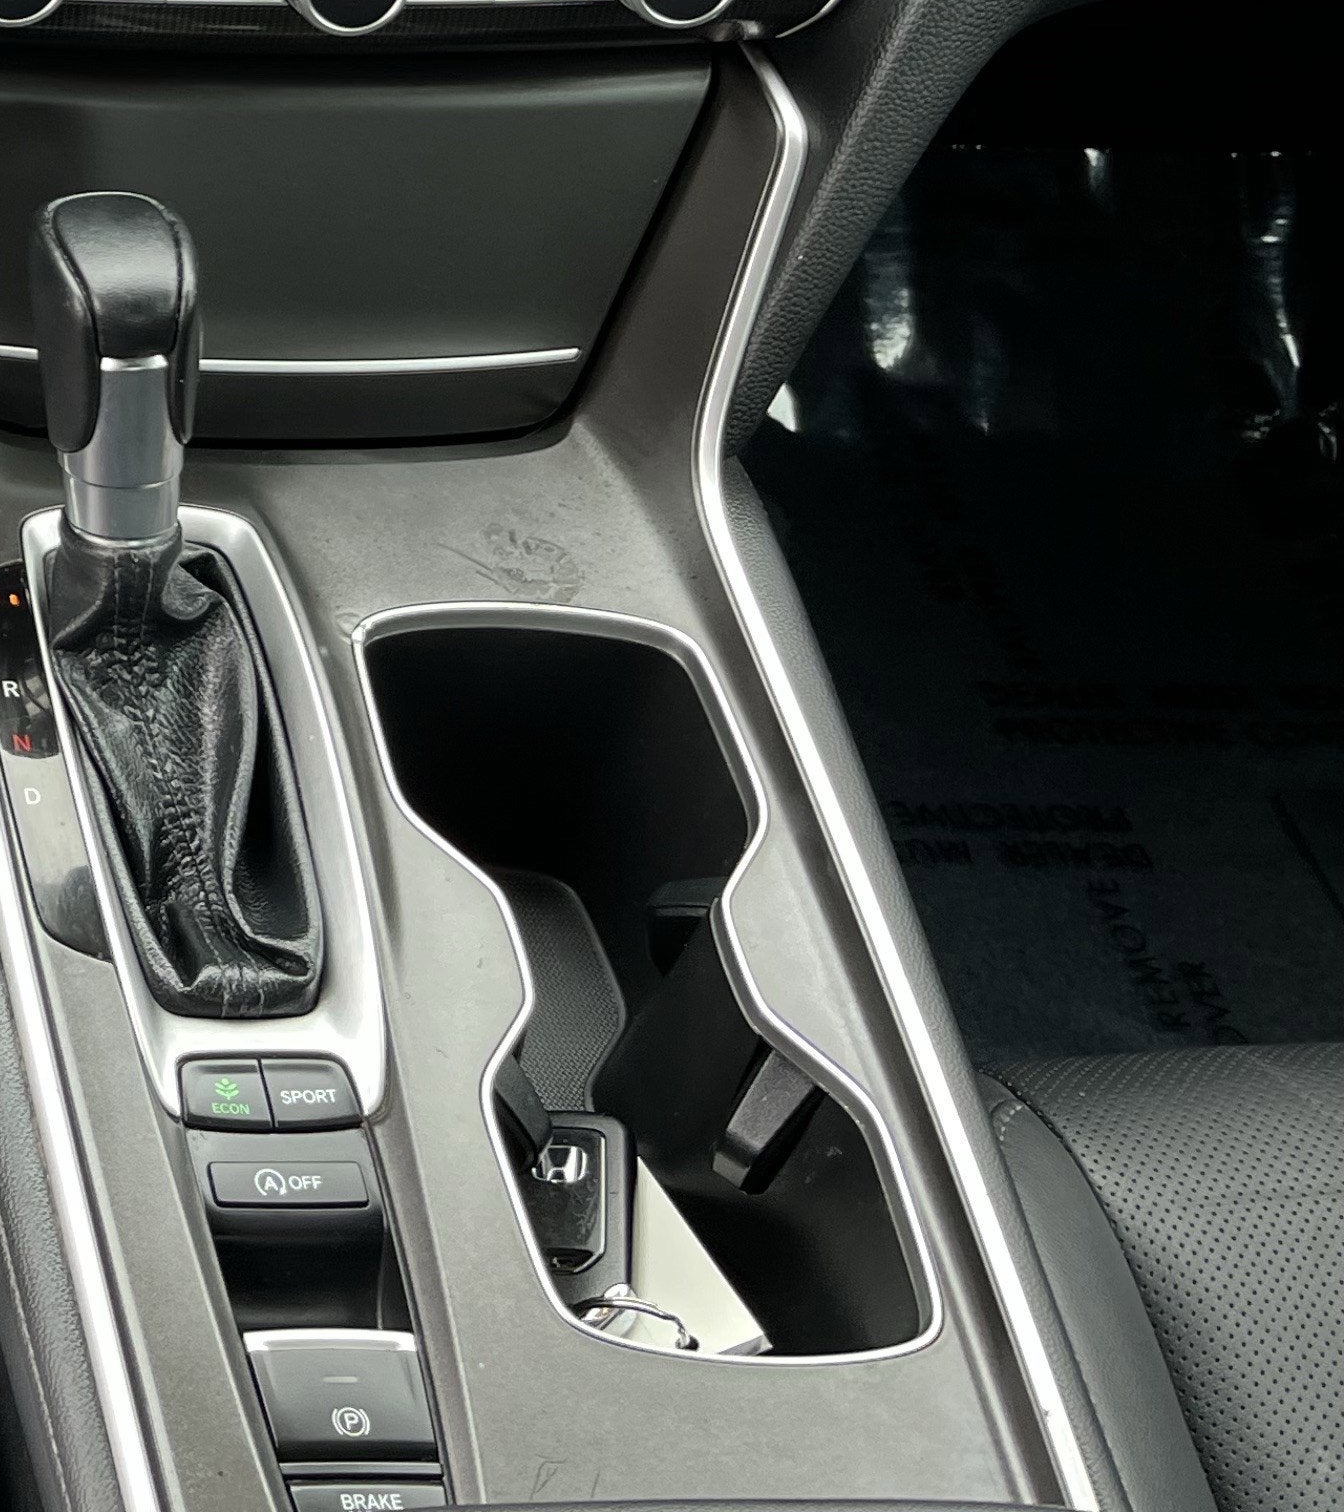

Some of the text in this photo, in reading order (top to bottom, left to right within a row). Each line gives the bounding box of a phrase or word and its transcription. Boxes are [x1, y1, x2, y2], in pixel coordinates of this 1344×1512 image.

[2, 680, 20, 698] R
[13, 734, 32, 752] N
[23, 788, 41, 806] D
[280, 1088, 337, 1106] SPORT
[211, 1102, 250, 1116] ECON
[289, 1175, 323, 1190] OFF
[340, 1493, 404, 1511] BRAKE
